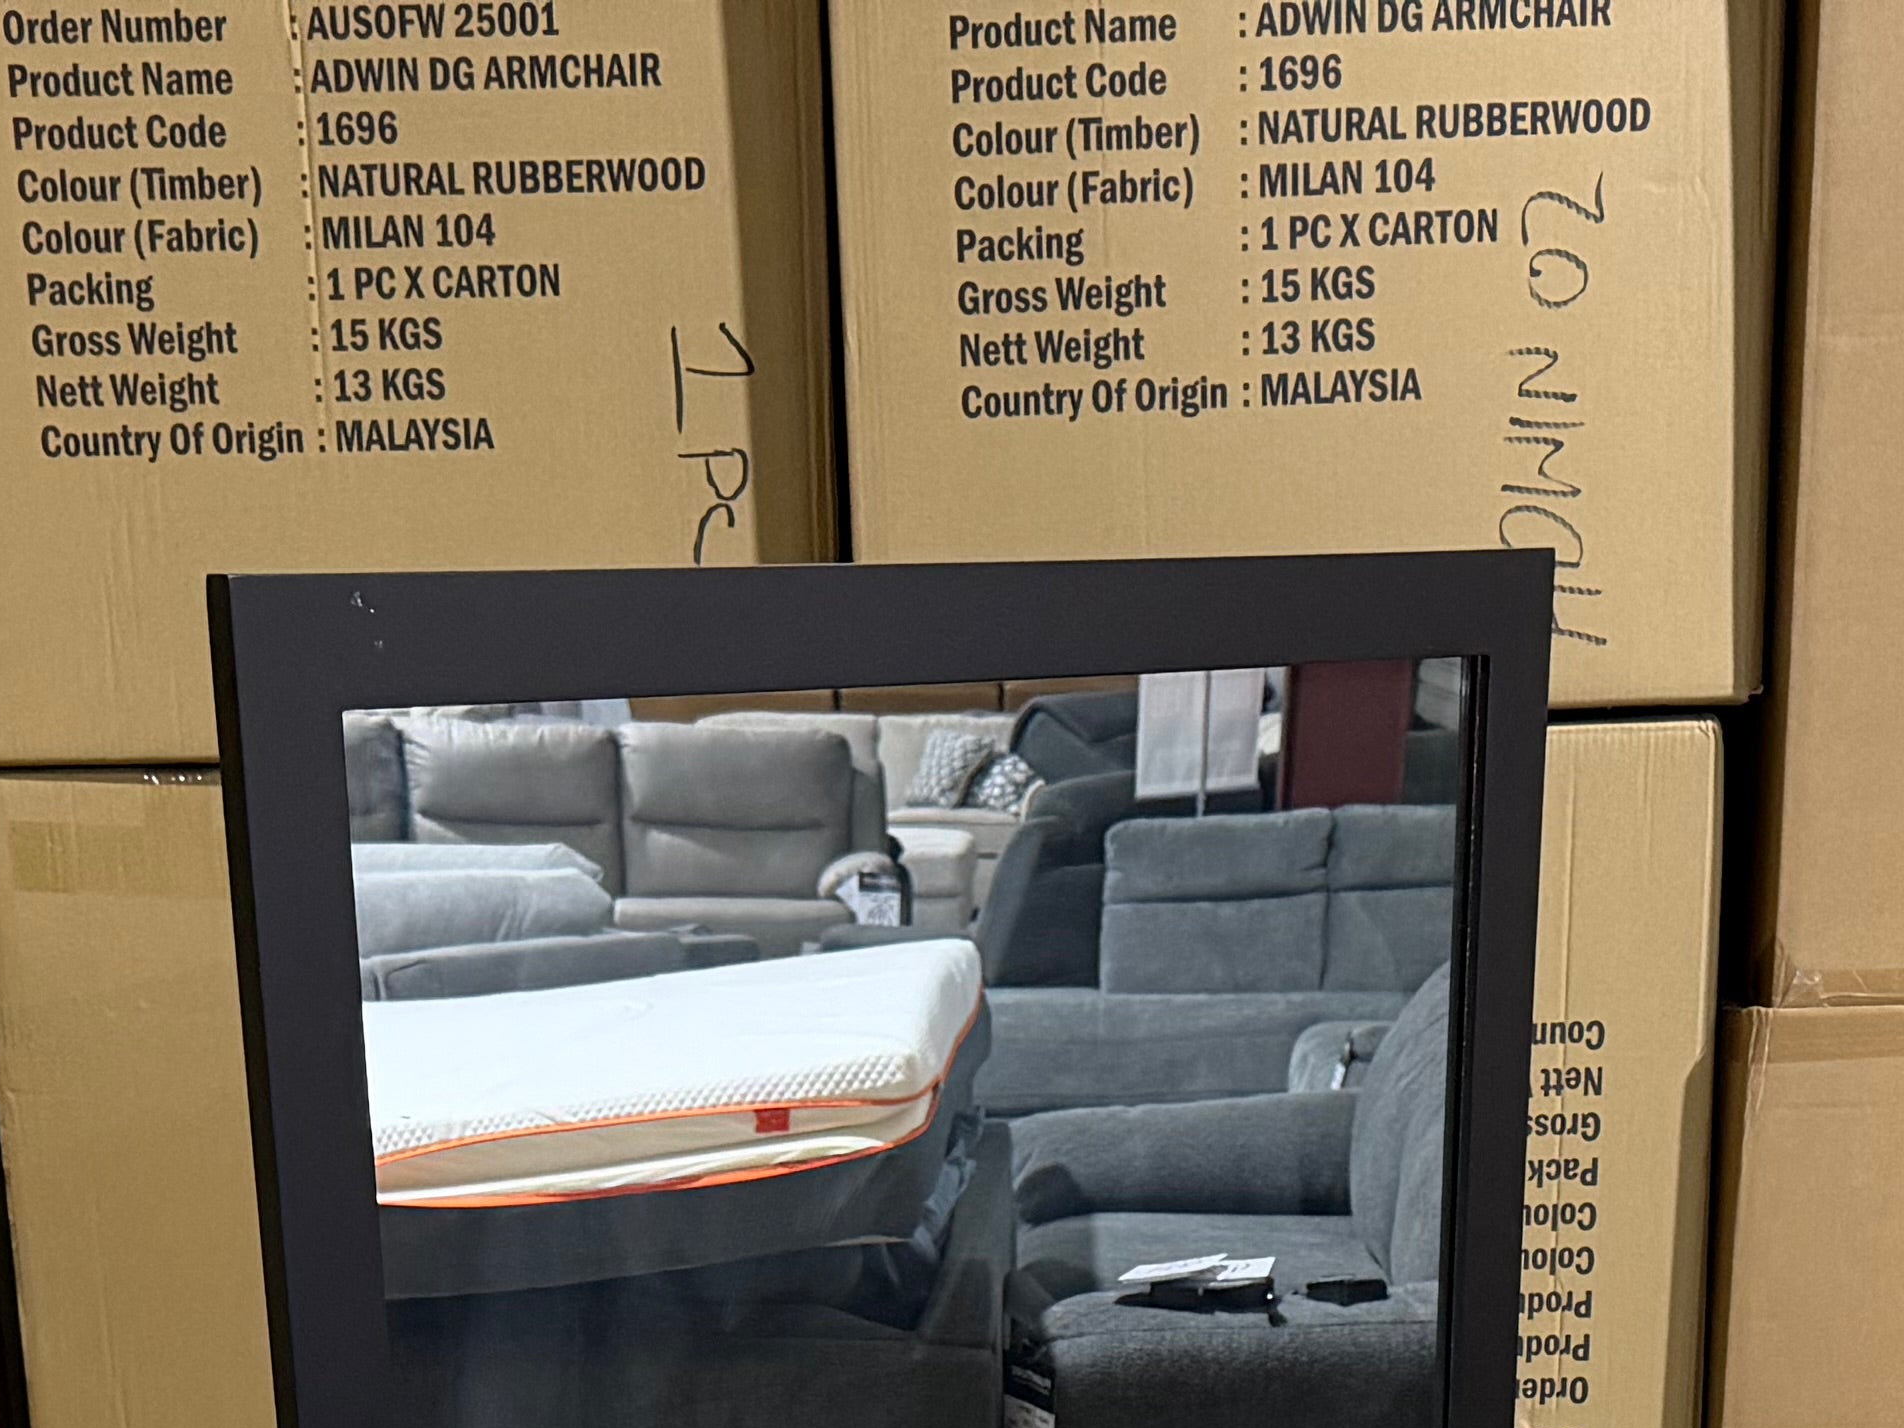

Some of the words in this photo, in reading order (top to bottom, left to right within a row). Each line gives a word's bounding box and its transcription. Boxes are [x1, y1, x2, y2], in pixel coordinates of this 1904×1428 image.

[1, 8, 94, 46] Order
[99, 6, 228, 44] Number
[305, 2, 446, 41] AUSOFW
[453, 0, 560, 38] 25001
[6, 61, 135, 99] Product
[140, 60, 234, 97] Name
[309, 55, 420, 94] ADWIN
[428, 55, 476, 92] DG
[482, 51, 663, 91] ARMCHAIR
[950, 63, 1079, 105] Product
[1084, 59, 1167, 99] Code
[1258, 52, 1342, 92] 1696
[11, 114, 140, 151] Product
[144, 112, 227, 149] Code
[315, 109, 399, 147] 1696
[951, 120, 1059, 159] Colour
[1064, 112, 1200, 161] (Timber)
[1257, 104, 1407, 146] NATURAL
[1415, 96, 1651, 140] RUBBERWOOD
[16, 167, 122, 204] Colour
[128, 164, 262, 211] (Timber)
[317, 160, 466, 199] NATURAL
[471, 155, 706, 196] RUBBERWOOD
[953, 173, 1060, 211] Colour
[1066, 165, 1194, 214] (Fabric)
[1258, 158, 1363, 199] MILAN
[1374, 156, 1436, 194] 104
[21, 219, 127, 256] Colour
[133, 216, 259, 262] (Fabric)
[321, 212, 425, 251] MILAN
[434, 211, 496, 248] 104
[955, 224, 1085, 267] Packing
[1260, 215, 1279, 251] 1
[1288, 213, 1332, 250] PC
[1338, 212, 1361, 249] X
[1367, 207, 1498, 247] CARTON
[25, 270, 156, 313] Packing
[326, 266, 346, 302] 1
[353, 265, 397, 301] PC
[402, 264, 426, 300] X
[431, 261, 561, 299] CARTON
[956, 279, 1049, 316] Gross
[1053, 273, 1167, 318] Weight
[1260, 267, 1301, 304] 15
[1309, 264, 1376, 302] KGS
[30, 322, 122, 358] Gross
[125, 320, 239, 363] Weight
[329, 319, 371, 354] 15
[377, 315, 443, 351] KGS
[959, 331, 1029, 368] Nett
[1032, 326, 1146, 370] Weight
[1261, 319, 1301, 356] 13
[1310, 316, 1376, 354] KGS
[35, 373, 105, 408] Nett
[107, 371, 221, 414] Weight
[333, 367, 373, 403] 13
[380, 366, 446, 402] KGS
[960, 381, 1084, 423] Country
[1090, 377, 1128, 414] Of
[1134, 374, 1228, 418] Origin
[1260, 366, 1423, 407] MALAYSIA
[39, 423, 162, 464] Country
[168, 420, 205, 456] Of
[211, 419, 305, 463] Origin
[334, 416, 495, 454] MALAYSIA
[1540, 1066, 1604, 1098] Nett
